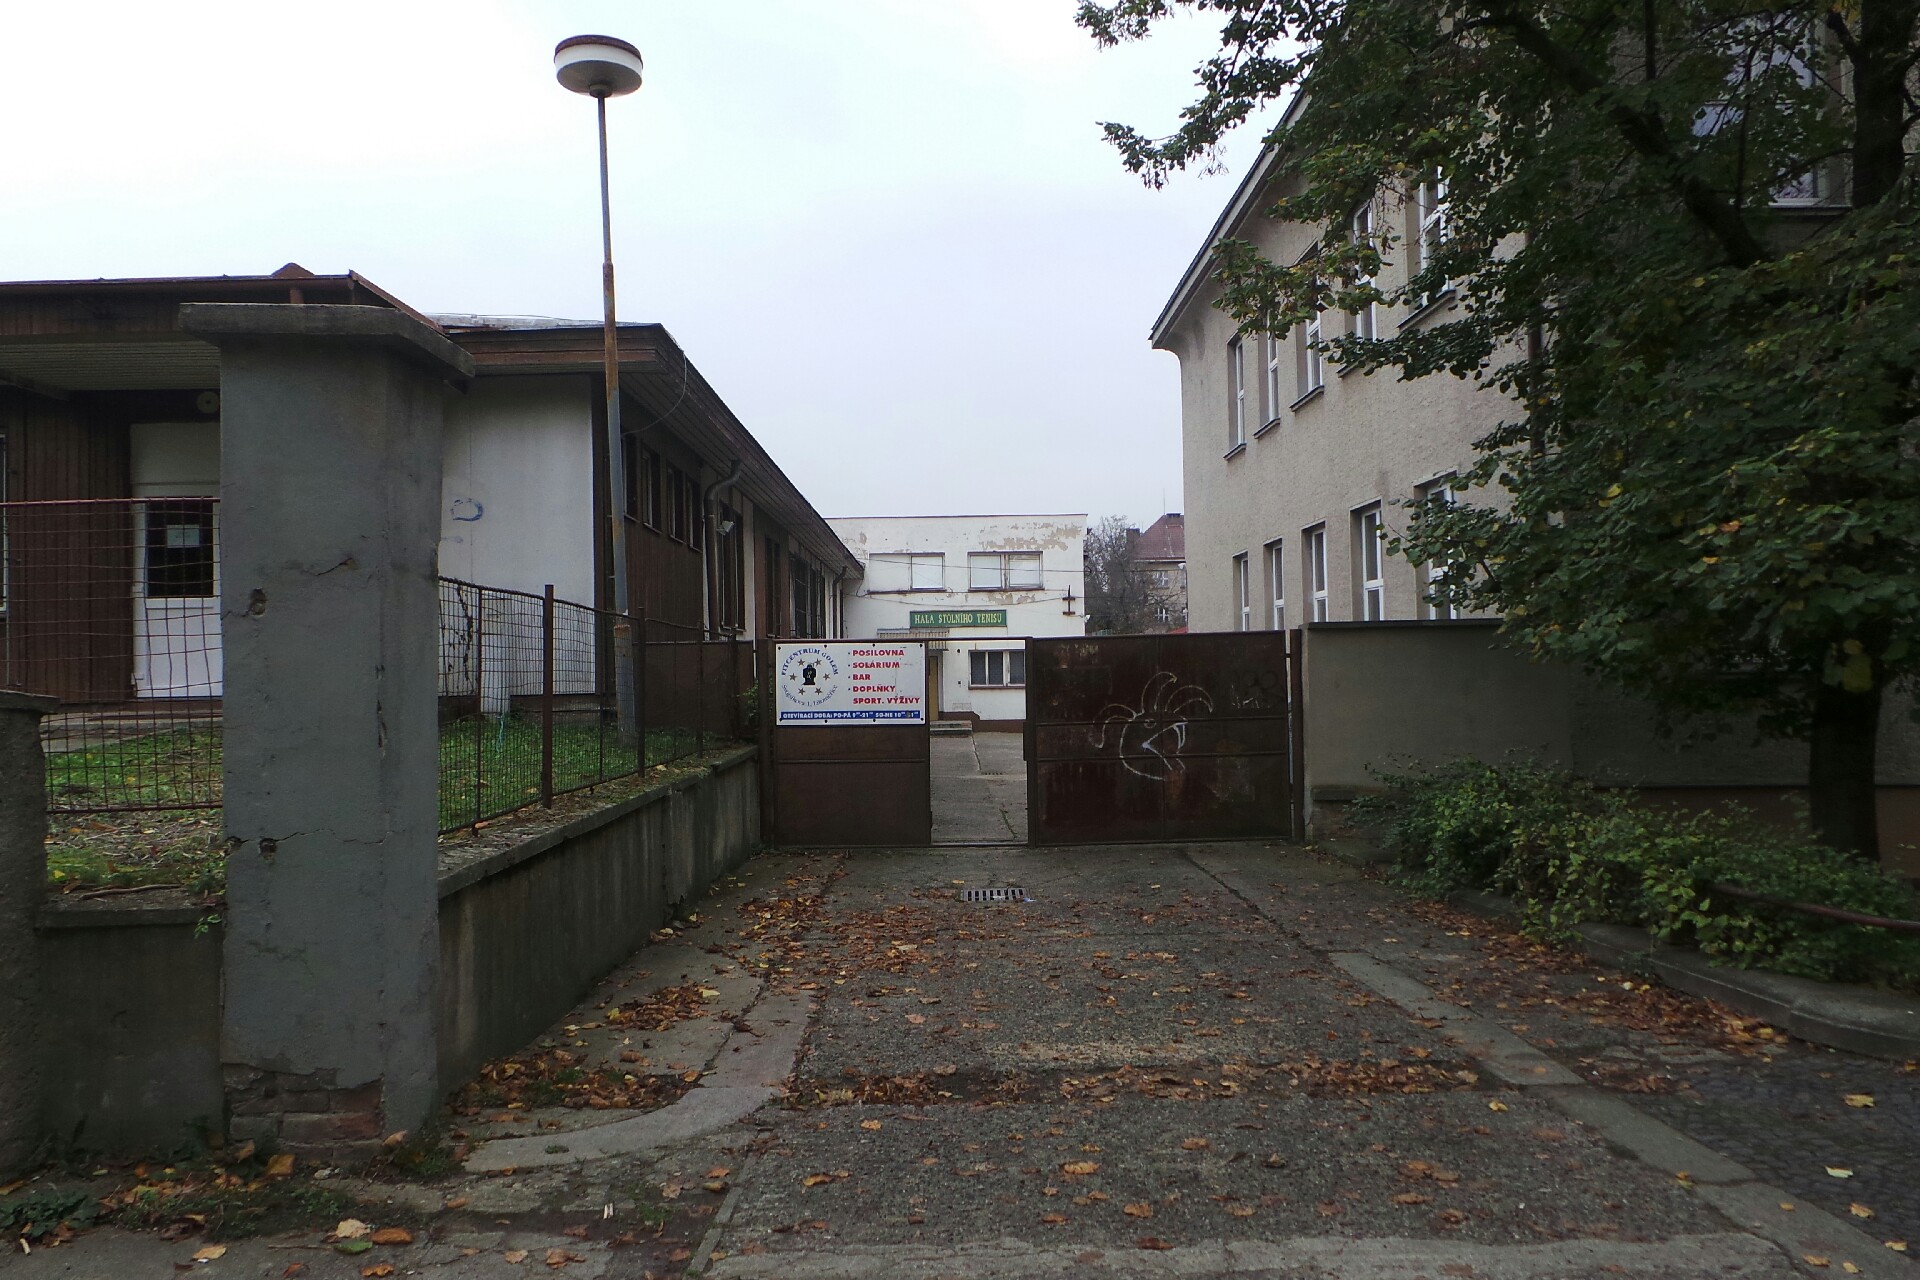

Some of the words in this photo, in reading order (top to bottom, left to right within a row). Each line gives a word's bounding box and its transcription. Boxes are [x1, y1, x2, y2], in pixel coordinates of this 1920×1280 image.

[914, 614, 935, 624] HALA
[938, 612, 973, 624] STOLNÍHO
[976, 613, 1002, 623] TENISU
[852, 649, 905, 657] POSILOVNA
[781, 648, 821, 676] FITCENTRUM
[821, 652, 839, 675] GOLEM
[852, 660, 900, 669] SOLÁRIUM
[852, 673, 871, 681] BAR
[852, 683, 896, 693] DOPLŇKY
[852, 697, 885, 705] SPORT.
[886, 695, 920, 704] VÝŽIVY
[833, 711, 851, 719] PO-PÁ
